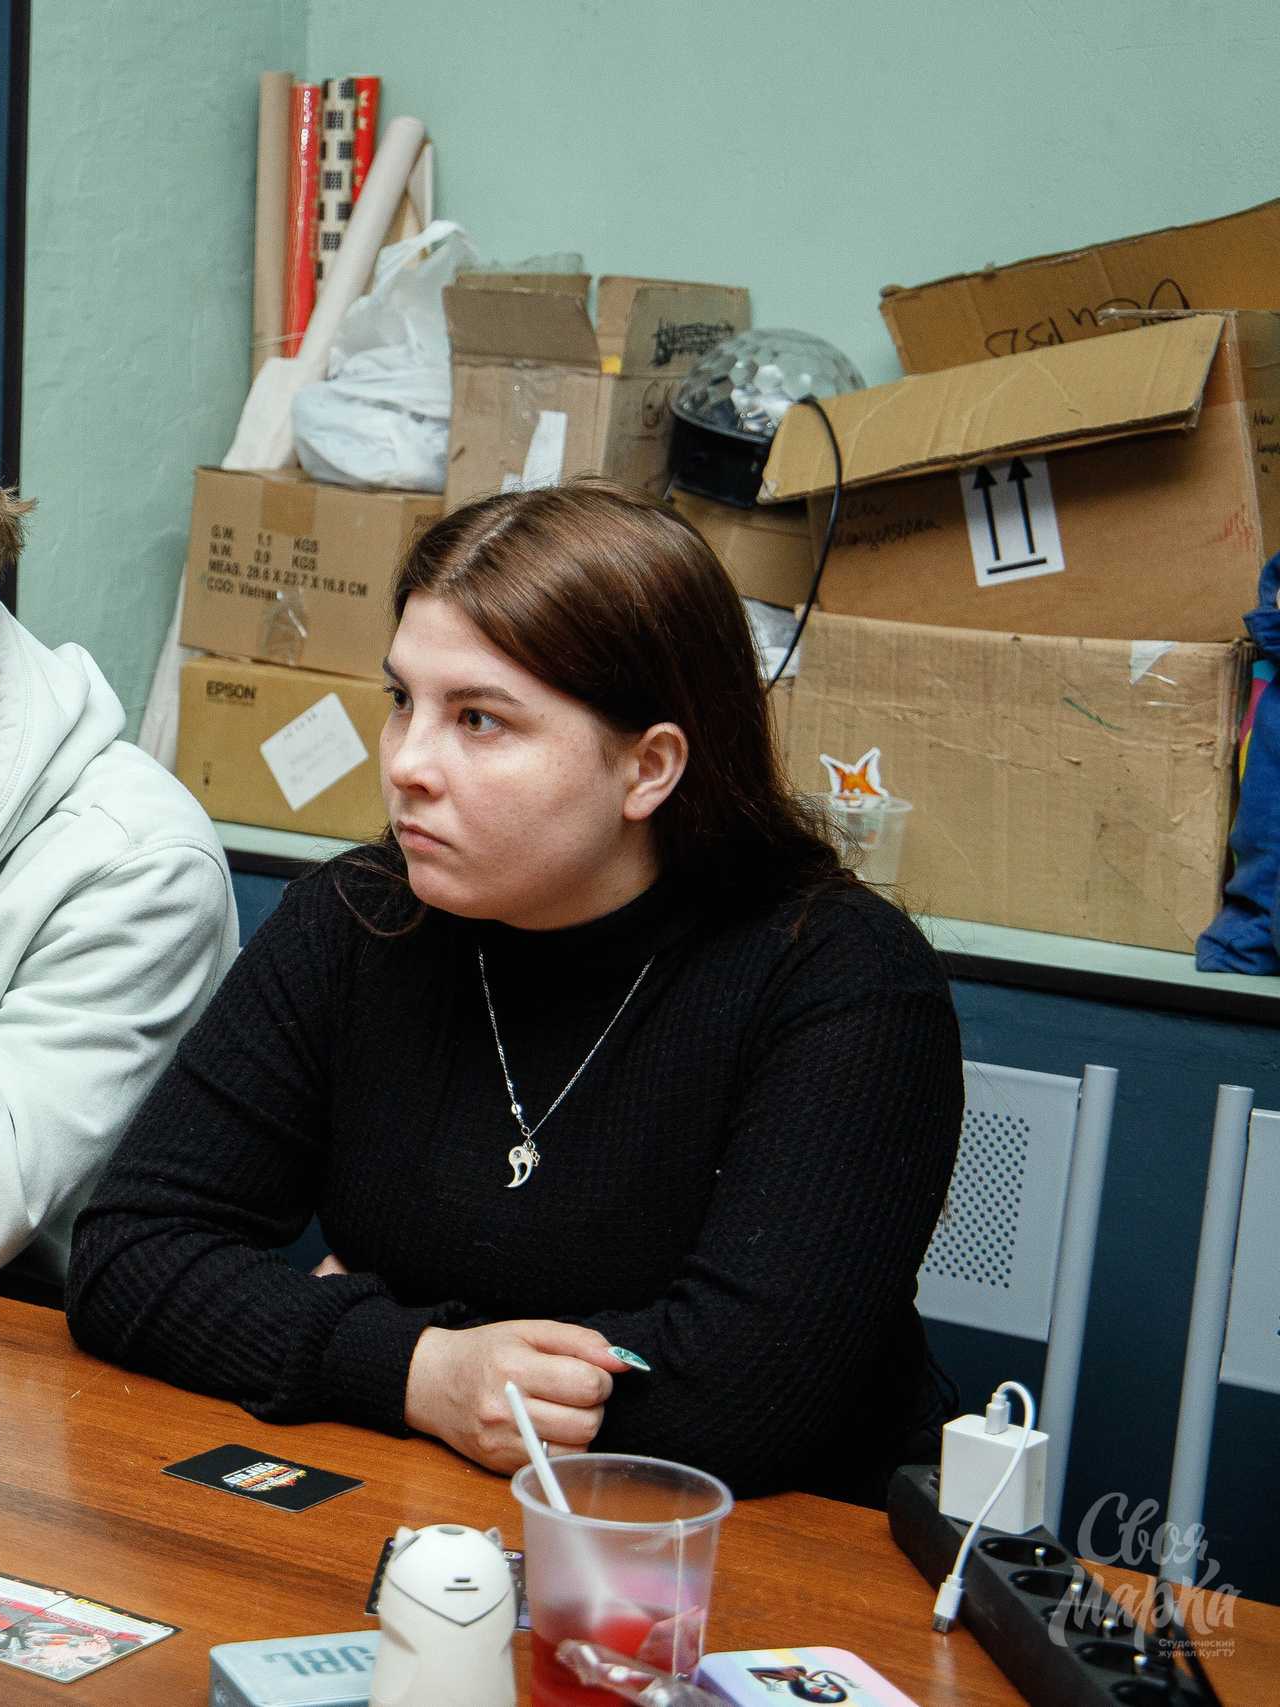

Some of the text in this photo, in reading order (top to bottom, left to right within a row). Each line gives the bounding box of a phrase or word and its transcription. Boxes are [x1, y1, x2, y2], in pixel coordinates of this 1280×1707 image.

[293, 538, 319, 554] KGS
[291, 555, 317, 571] KGS
[348, 581, 368, 597] CM
[206, 680, 257, 700] EPSON
[263, 1645, 374, 1676] JBL
